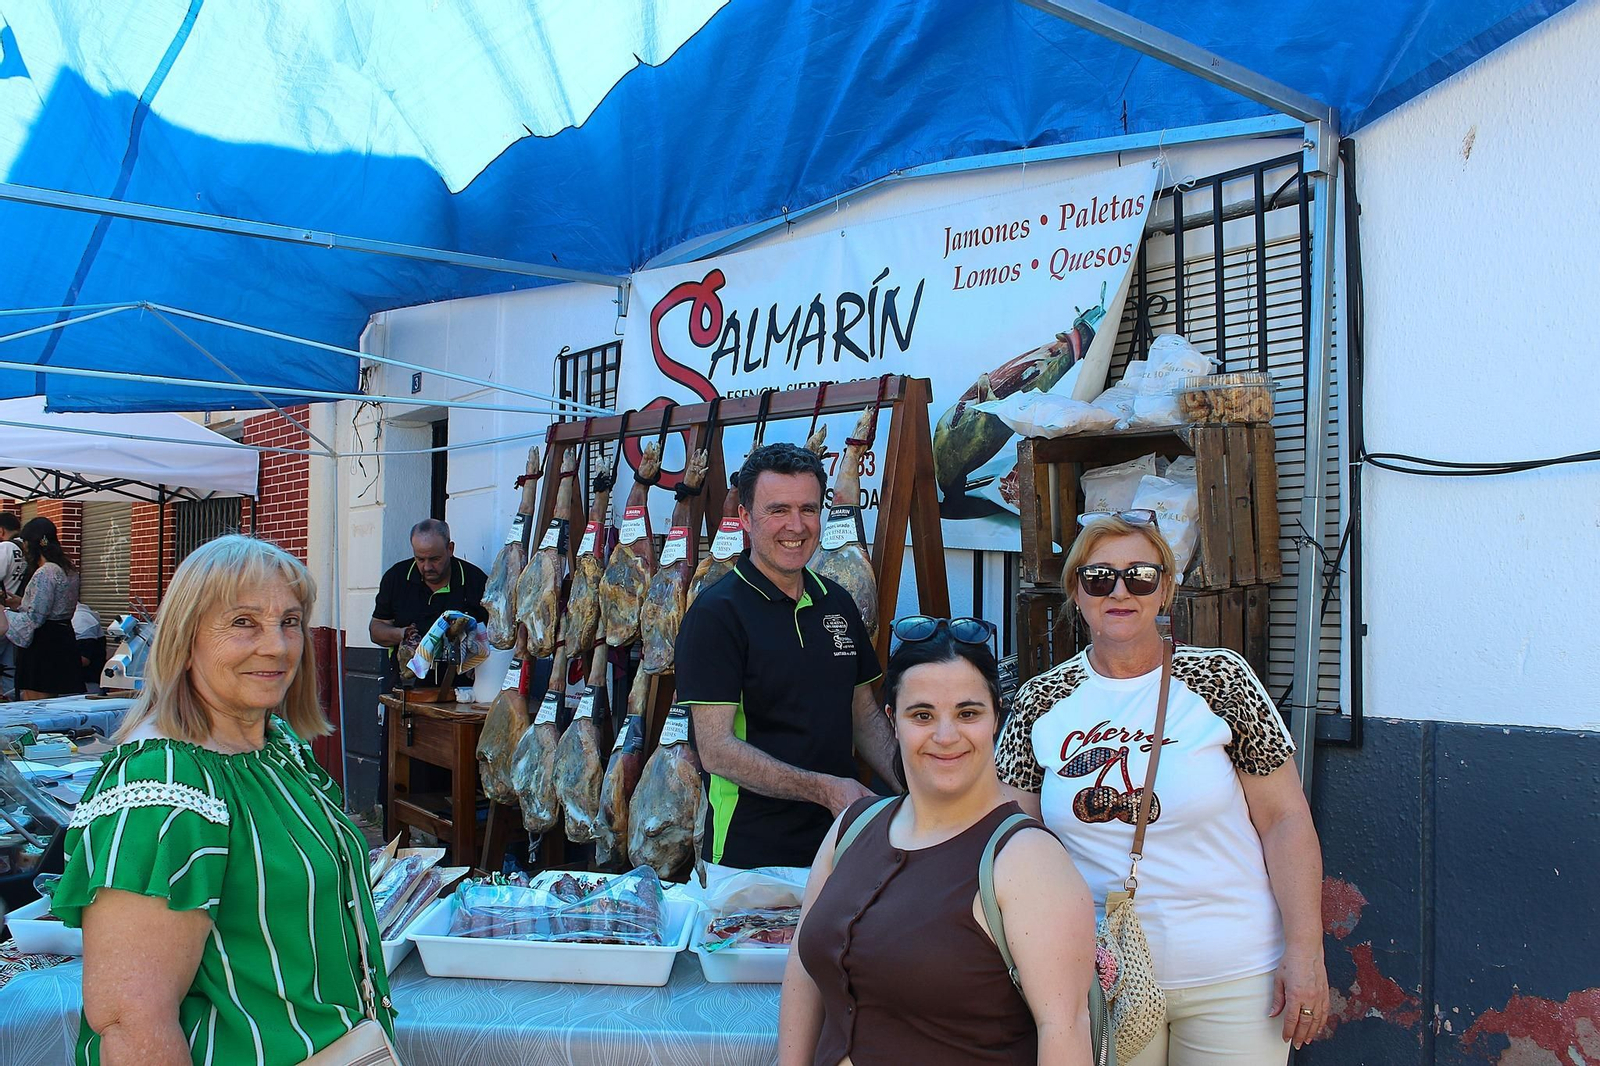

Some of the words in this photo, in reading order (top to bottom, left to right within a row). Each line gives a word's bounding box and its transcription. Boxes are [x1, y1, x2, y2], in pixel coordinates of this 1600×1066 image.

[944, 219, 1030, 259] Jamones
[1058, 194, 1145, 231] Paletas
[952, 262, 1021, 290] Lomos
[1049, 243, 1133, 280] Quesos
